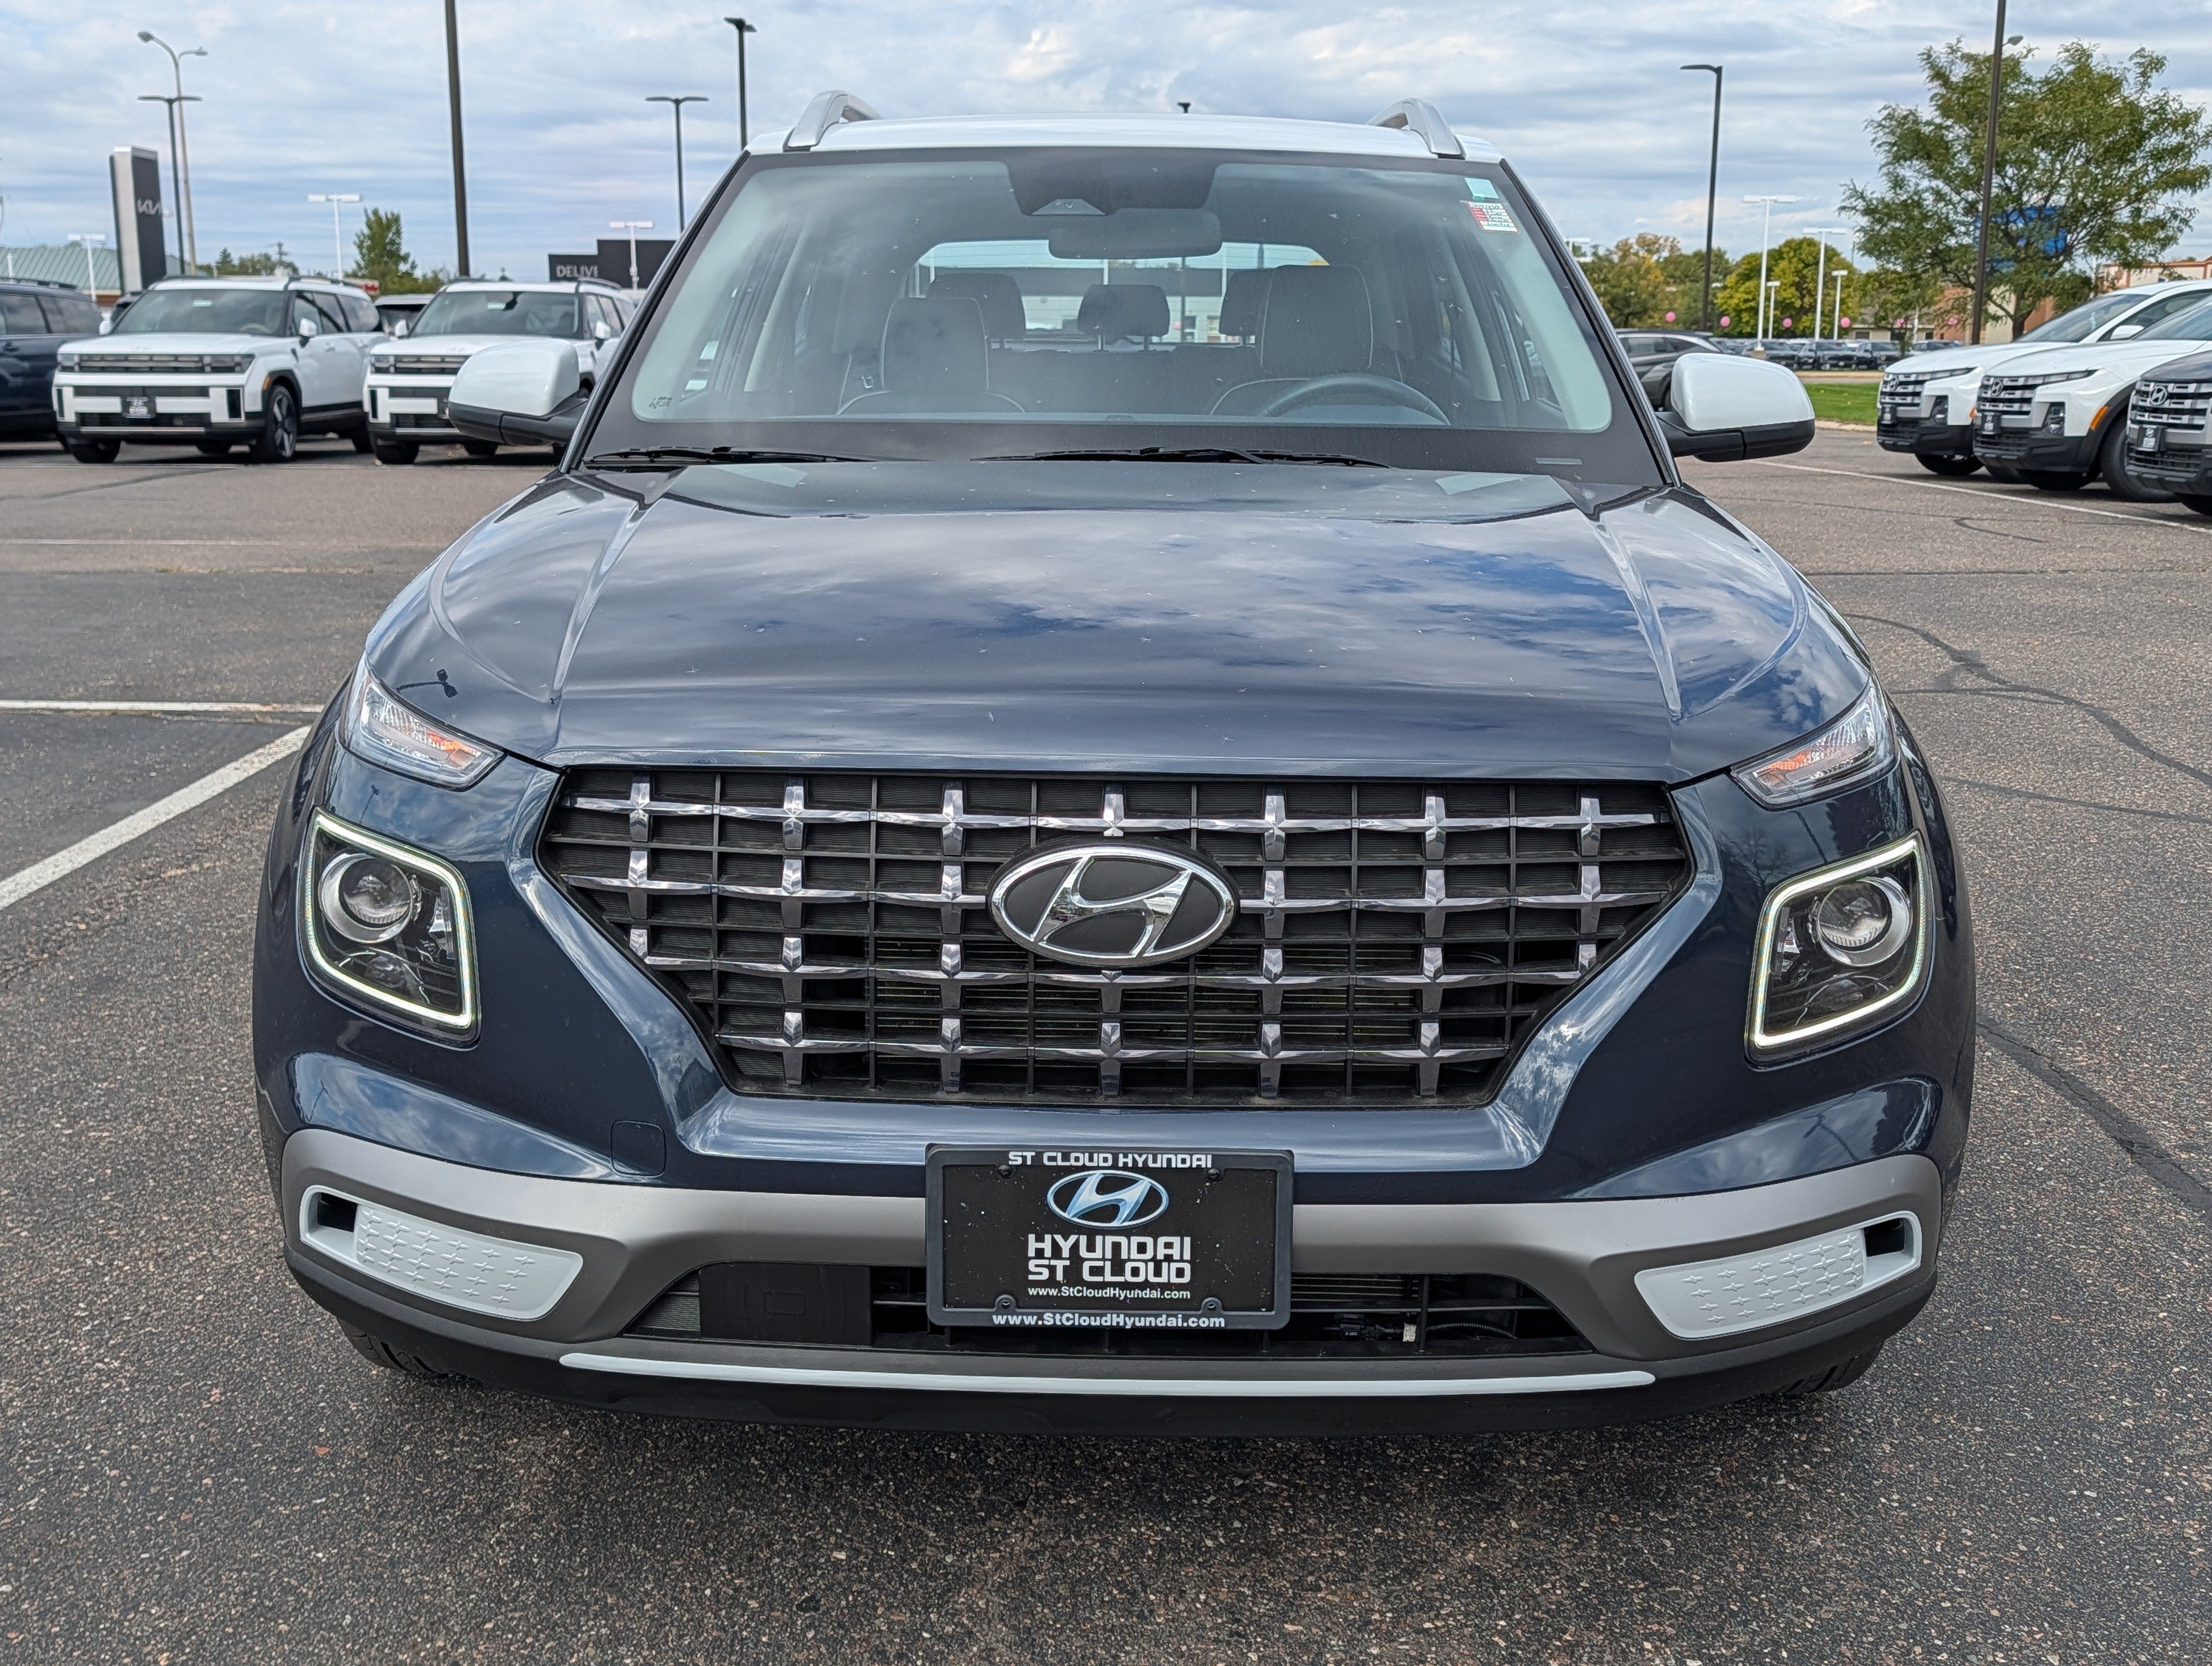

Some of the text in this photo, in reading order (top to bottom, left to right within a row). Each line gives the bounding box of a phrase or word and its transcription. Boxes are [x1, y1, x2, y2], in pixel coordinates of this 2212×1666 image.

[1008, 1151, 1212, 1168] ST CLOUD HYUNDAI
[1028, 1234, 1191, 1260] HYUNDAI
[1028, 1259, 1191, 1284] ST CLOUD
[1028, 1286, 1191, 1300] www.StCloudHyundai.com
[992, 1312, 1225, 1329] www.StCloudHyundai.com
